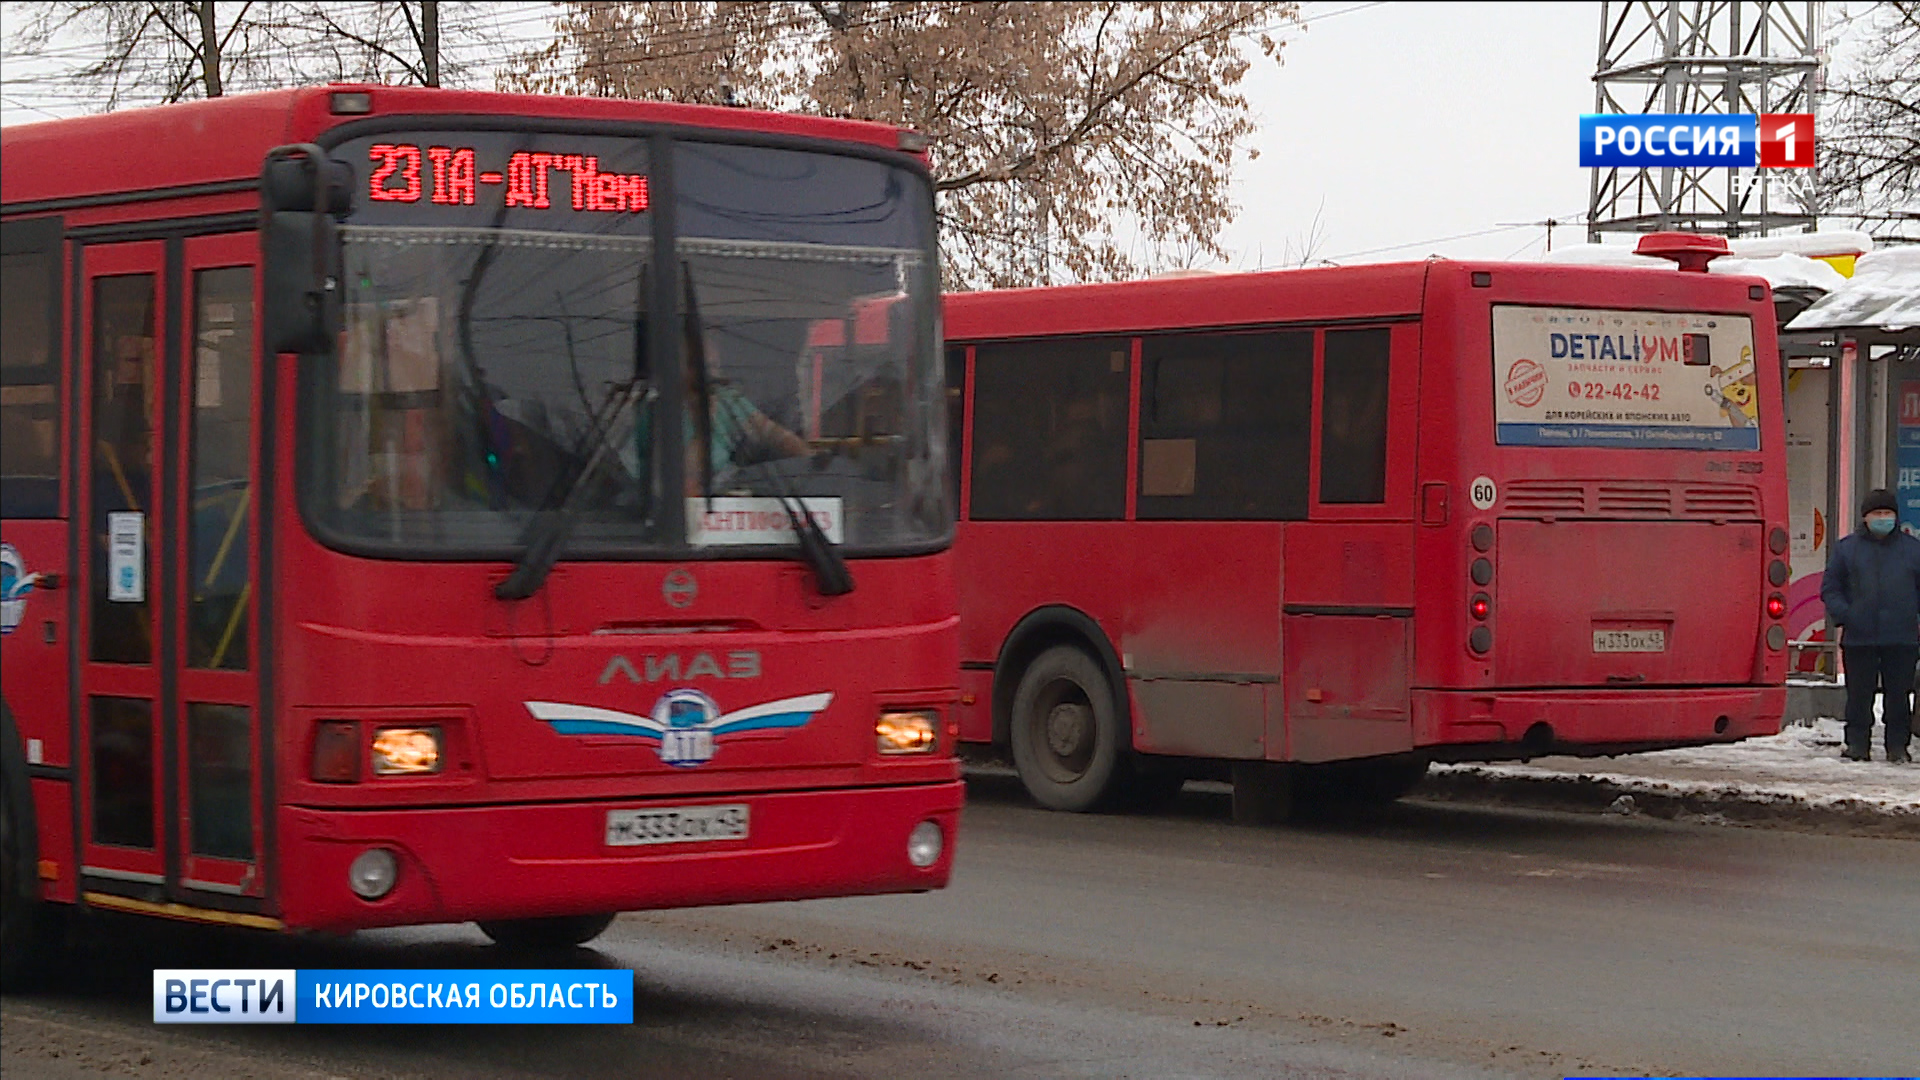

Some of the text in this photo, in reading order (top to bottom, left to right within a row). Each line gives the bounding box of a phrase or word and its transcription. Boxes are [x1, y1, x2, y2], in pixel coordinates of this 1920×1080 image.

[369, 144, 421, 203] 23
[1584, 382, 1660, 401] 22-42-42
[1564, 409, 1614, 421] КОРЕЙСКИХ
[1624, 412, 1669, 422] ЯПОНСКИХ
[1671, 413, 1691, 422] АВТО
[1474, 484, 1493, 502] 60
[599, 650, 762, 684] ЛИАЗ
